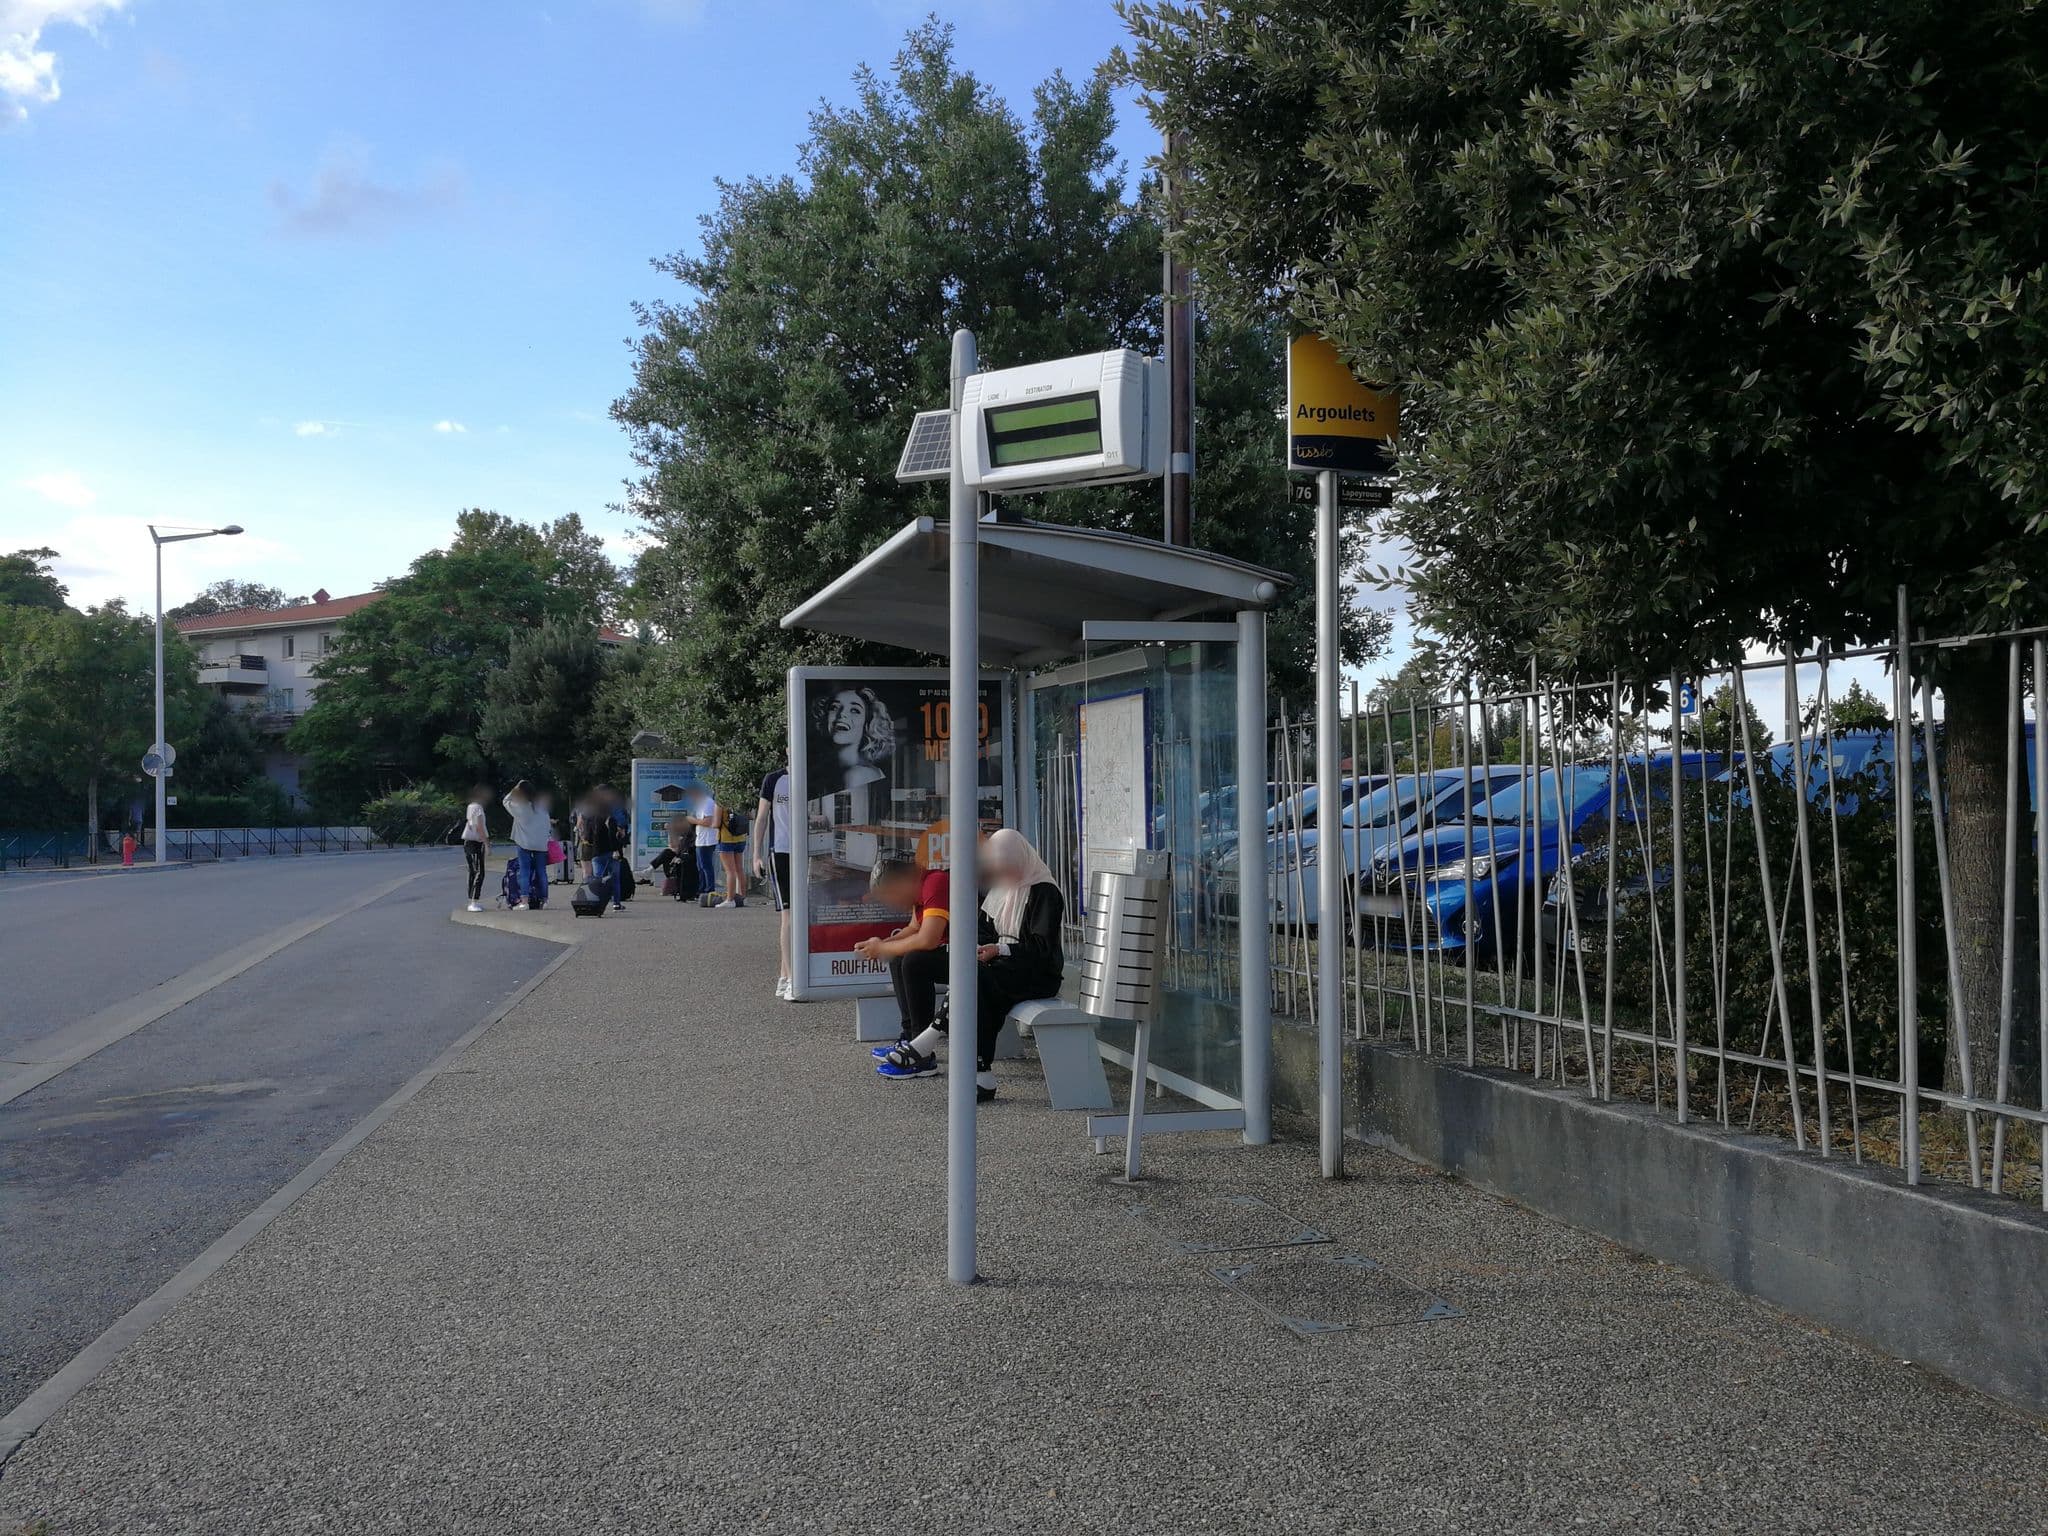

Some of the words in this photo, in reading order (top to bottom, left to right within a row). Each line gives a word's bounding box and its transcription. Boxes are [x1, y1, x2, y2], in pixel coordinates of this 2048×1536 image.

[1296, 404, 1376, 422] Argoulets
[1296, 487, 1312, 500] 76
[1341, 489, 1383, 499] Lapeyrouse
